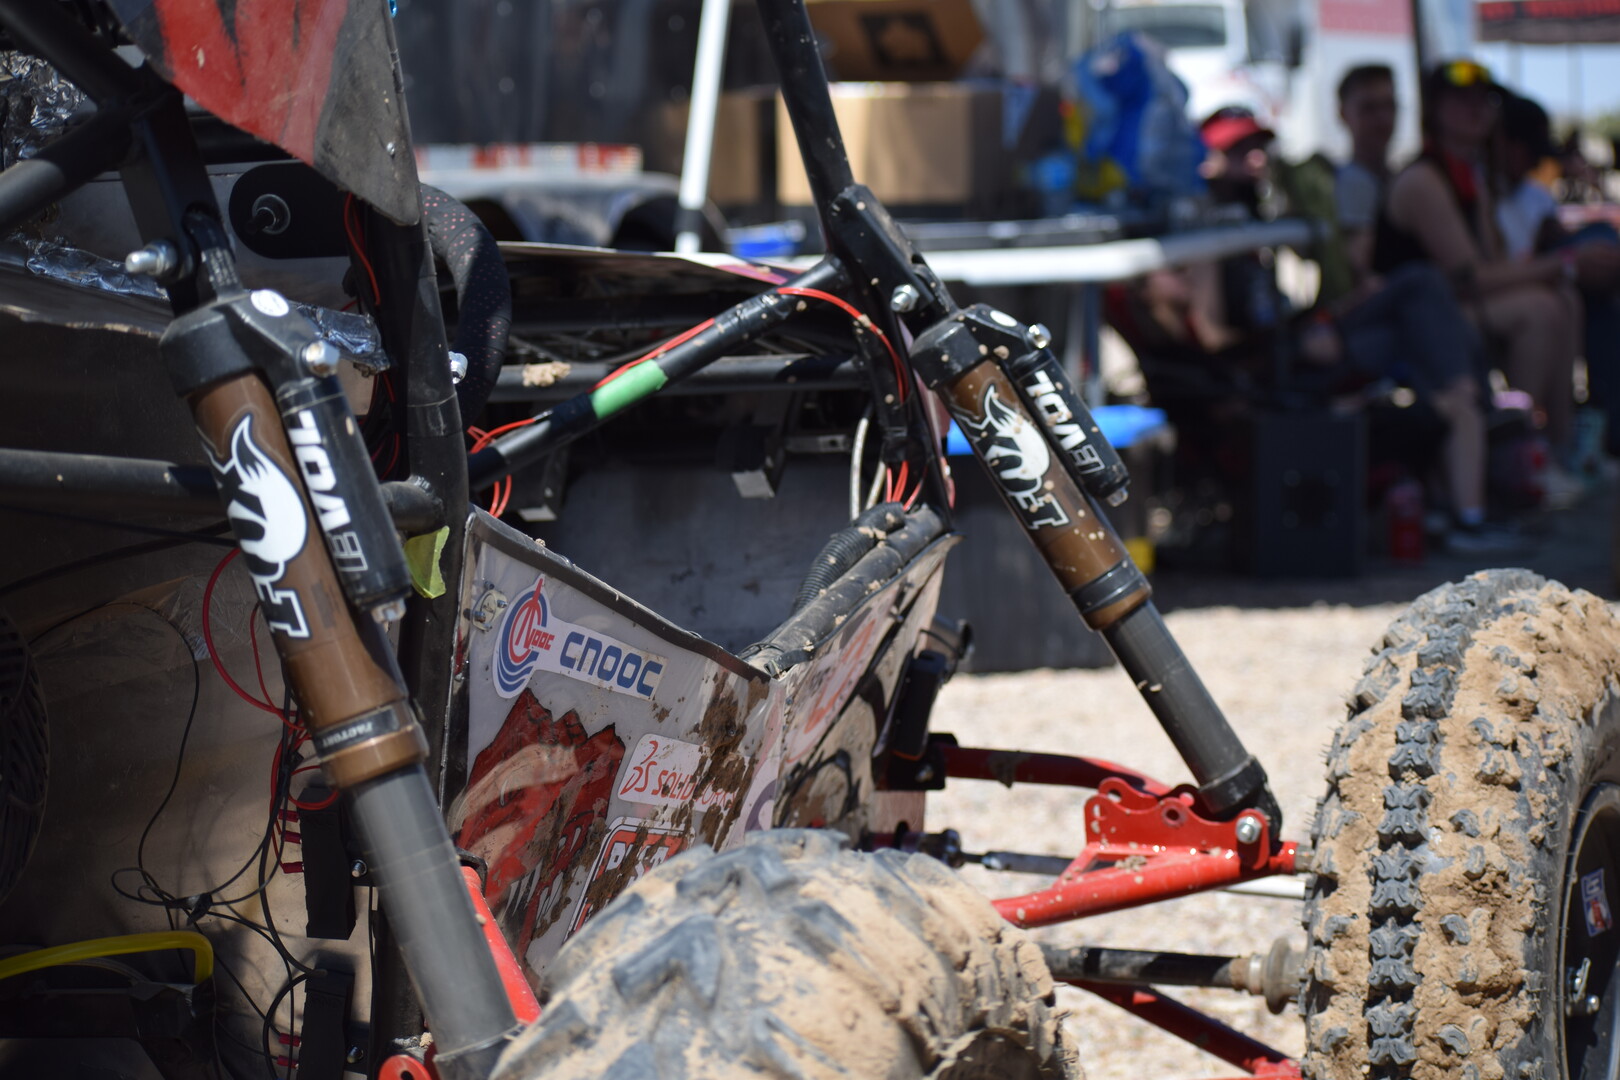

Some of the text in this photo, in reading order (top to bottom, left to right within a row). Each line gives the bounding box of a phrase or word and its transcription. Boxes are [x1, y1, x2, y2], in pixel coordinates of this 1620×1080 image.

[288, 410, 369, 572] EVOL
[950, 384, 1069, 529] FOX
[1025, 370, 1105, 474] EVOL
[200, 413, 310, 638] FOX
